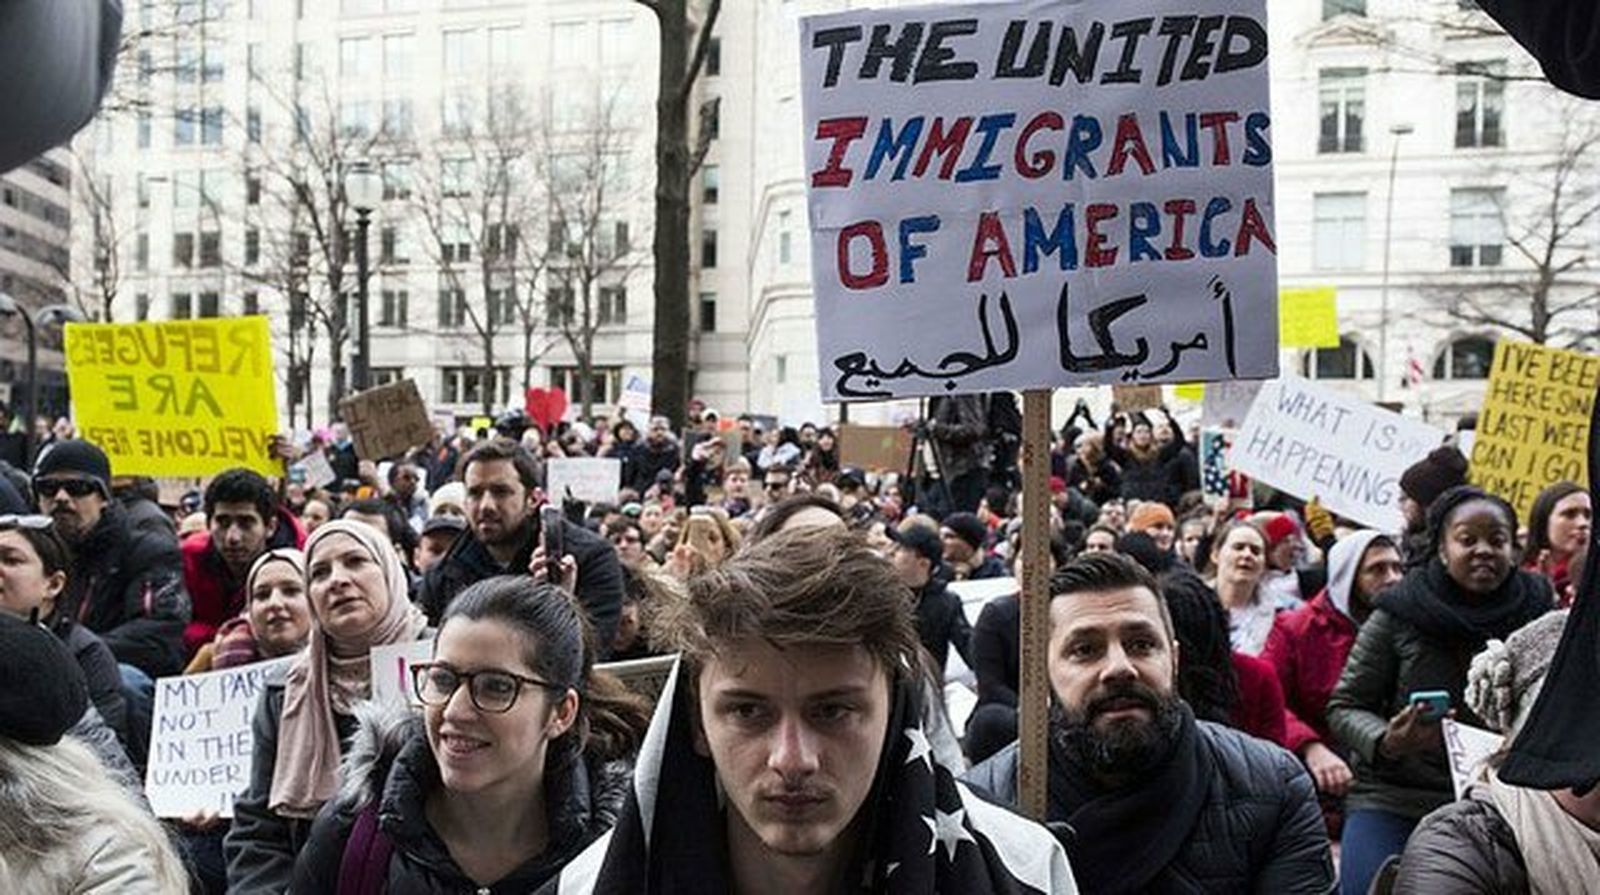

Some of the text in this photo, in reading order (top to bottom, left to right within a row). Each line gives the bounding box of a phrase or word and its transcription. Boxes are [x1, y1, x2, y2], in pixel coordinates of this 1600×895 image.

[812, 15, 1268, 87] THE UNITED
[811, 110, 1272, 188] IMMIGRANTS
[837, 198, 1277, 290] OF AMERICA
[834, 289, 1019, 397] للجميع
[1057, 275, 1238, 382] أمريكا
[1500, 343, 1544, 379] I'VE
[1492, 377, 1555, 412] HERE
[1277, 384, 1350, 435] WHAT
[1362, 419, 1398, 452] IS
[1482, 408, 1537, 444] LAST
[1246, 426, 1399, 507] HAPPENING
[1471, 440, 1517, 470] CAN
[1527, 452, 1537, 476] I
[1543, 453, 1582, 483] GO
[164, 678, 207, 708] MY
[159, 708, 219, 735] NOT
[157, 729, 251, 763] IN THE
[153, 763, 246, 786] UNDER
